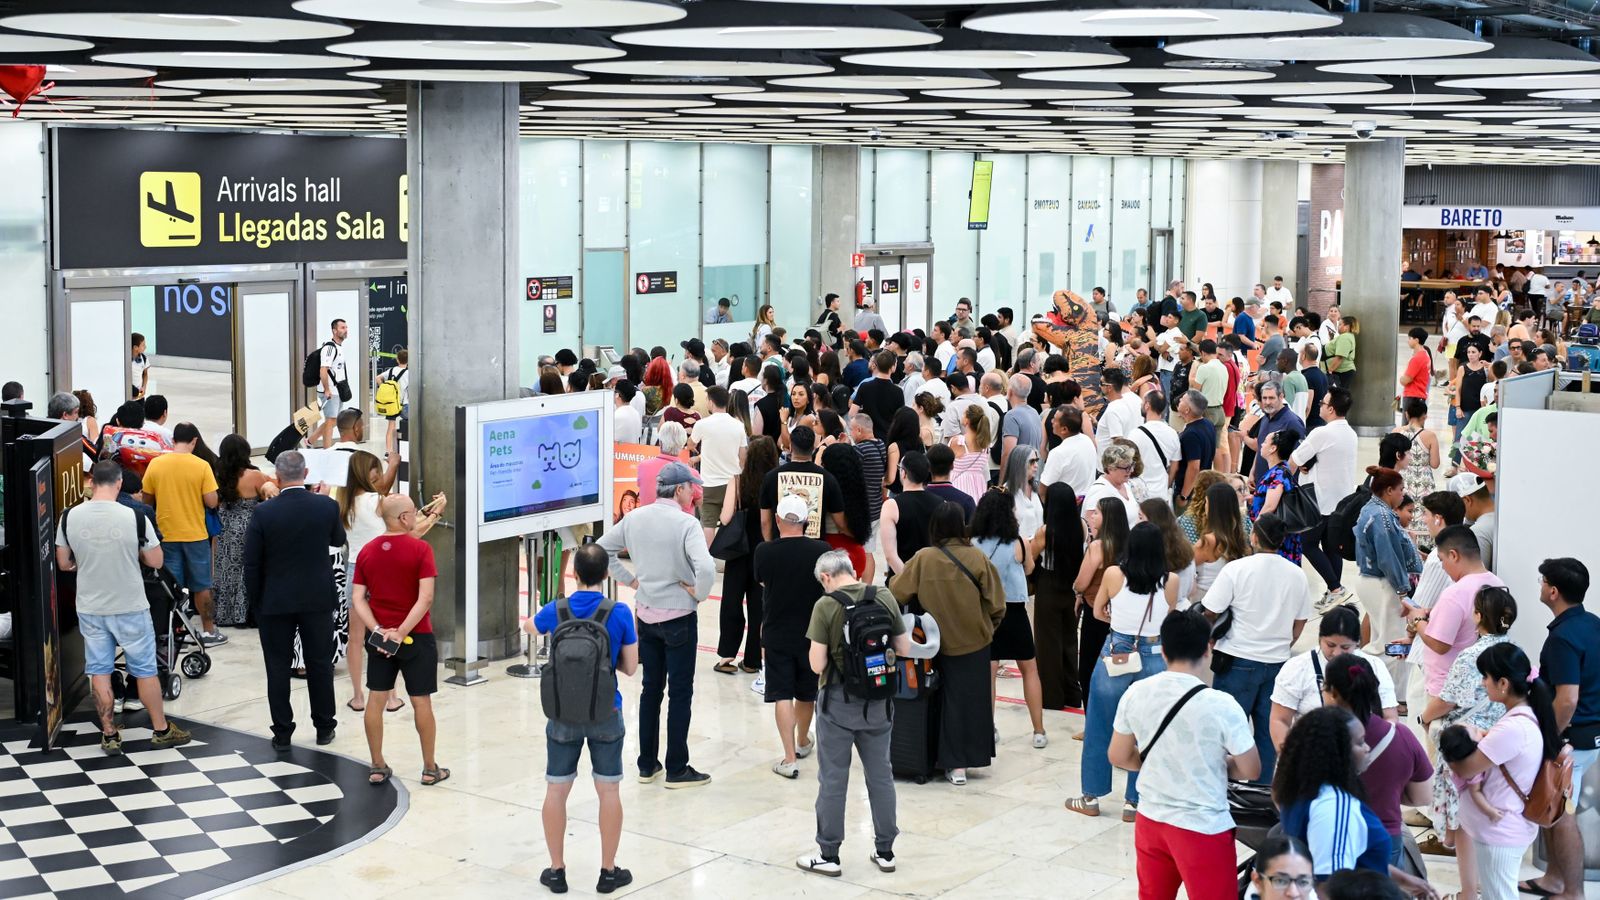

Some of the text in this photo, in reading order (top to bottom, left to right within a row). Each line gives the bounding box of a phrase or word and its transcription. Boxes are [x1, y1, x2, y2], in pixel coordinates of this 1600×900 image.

[217, 176, 340, 202] Arrivals hall
[1441, 208, 1502, 227] BARETO
[218, 211, 385, 248] Llegadas Sala
[164, 284, 203, 314] no
[489, 430, 516, 441] Aena
[489, 445, 513, 456] Pets
[780, 474, 822, 487] WANTED
[867, 665, 886, 674] PRESS
